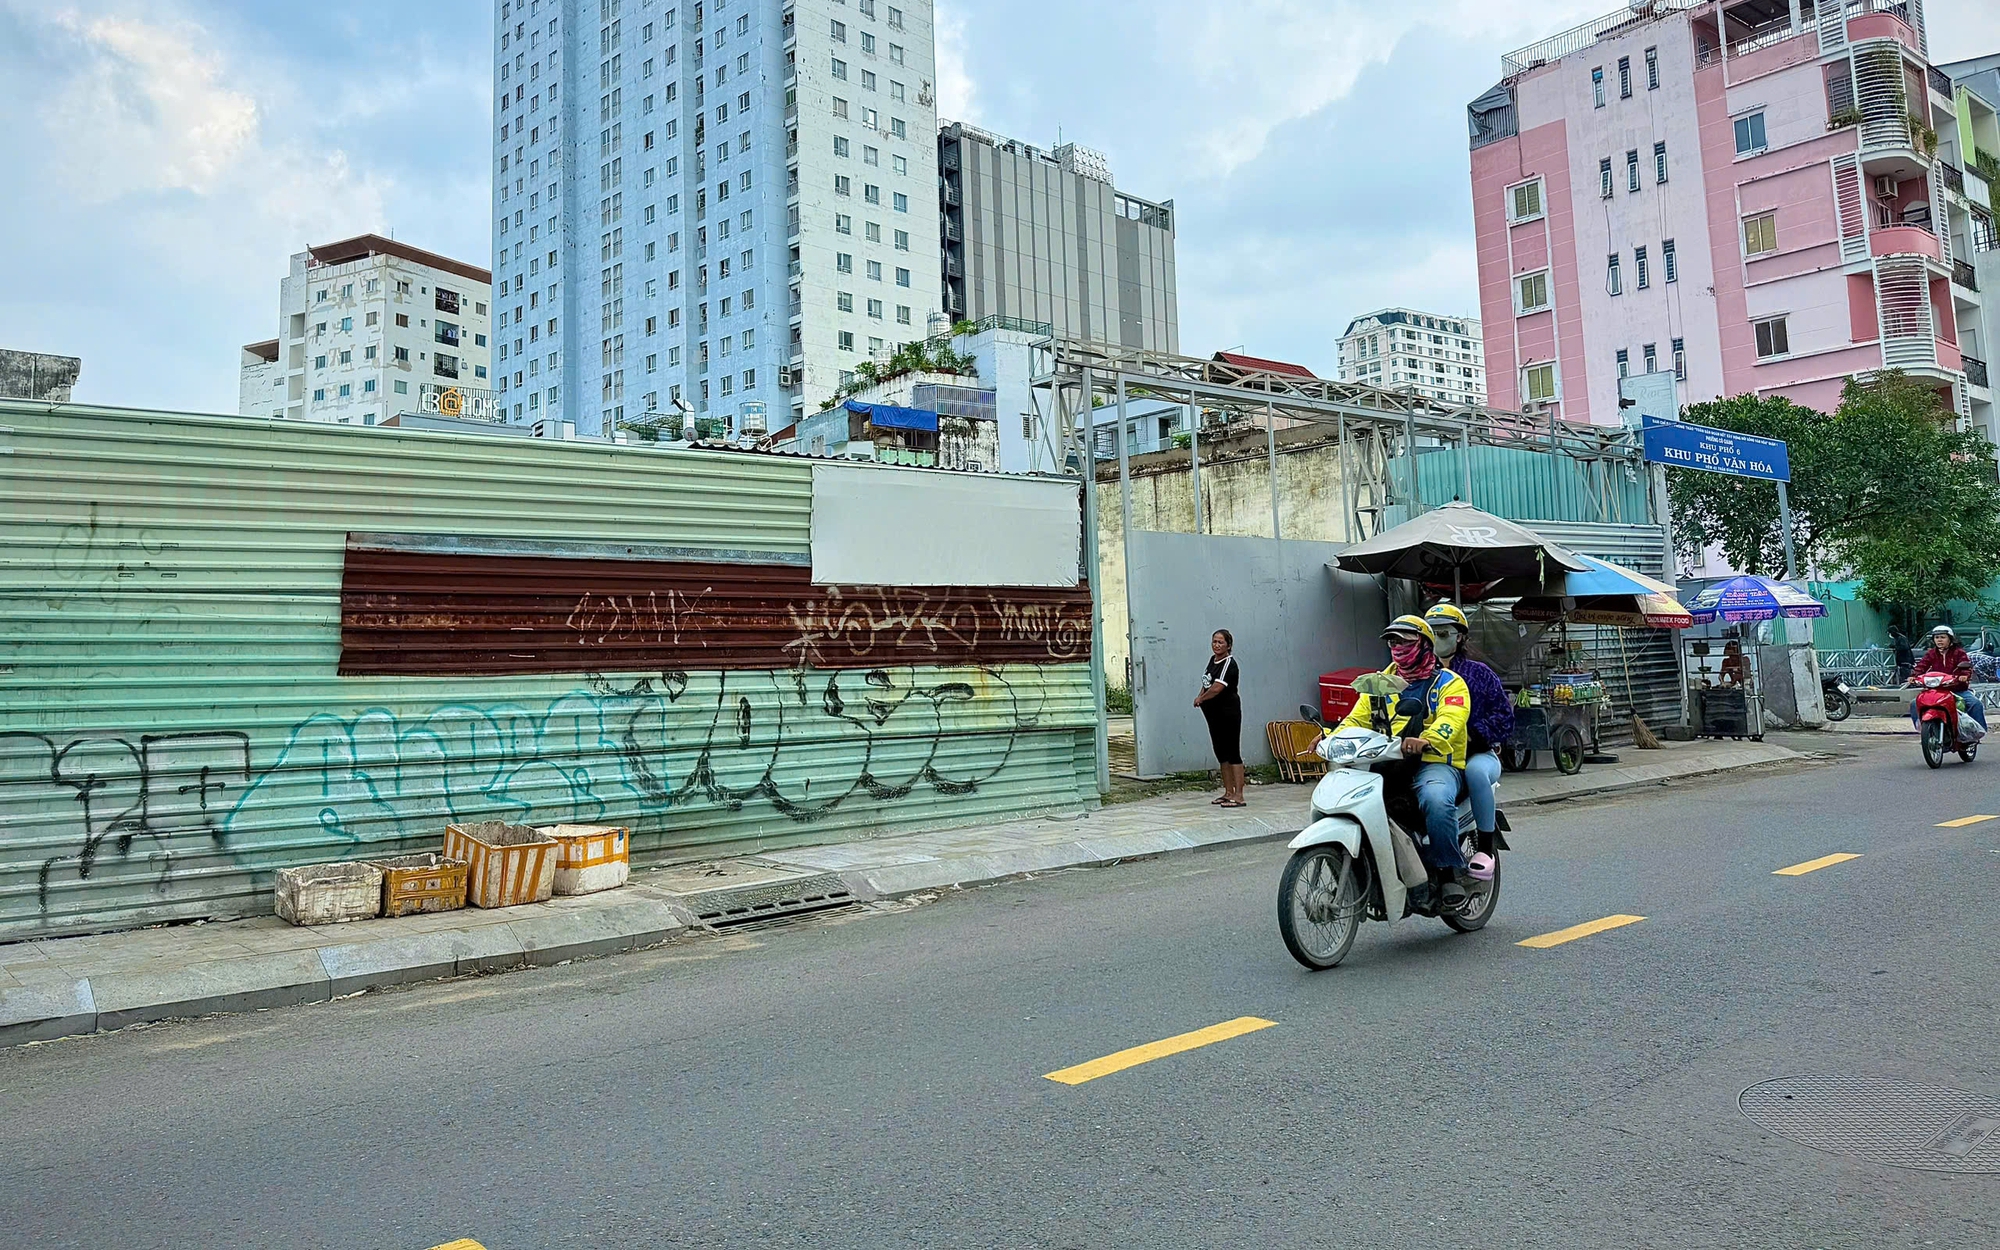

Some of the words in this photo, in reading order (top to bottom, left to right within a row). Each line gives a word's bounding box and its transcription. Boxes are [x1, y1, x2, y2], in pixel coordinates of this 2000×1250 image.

[1700, 442, 1717, 451] KHU
[1719, 445, 1735, 454] PHỐ
[1664, 447, 1692, 461] KHU
[1695, 452, 1720, 466] PHỐ
[1723, 457, 1746, 470] VĂN
[1750, 461, 1774, 474] HÓA
[1647, 616, 1673, 624] CHOLIMEX
